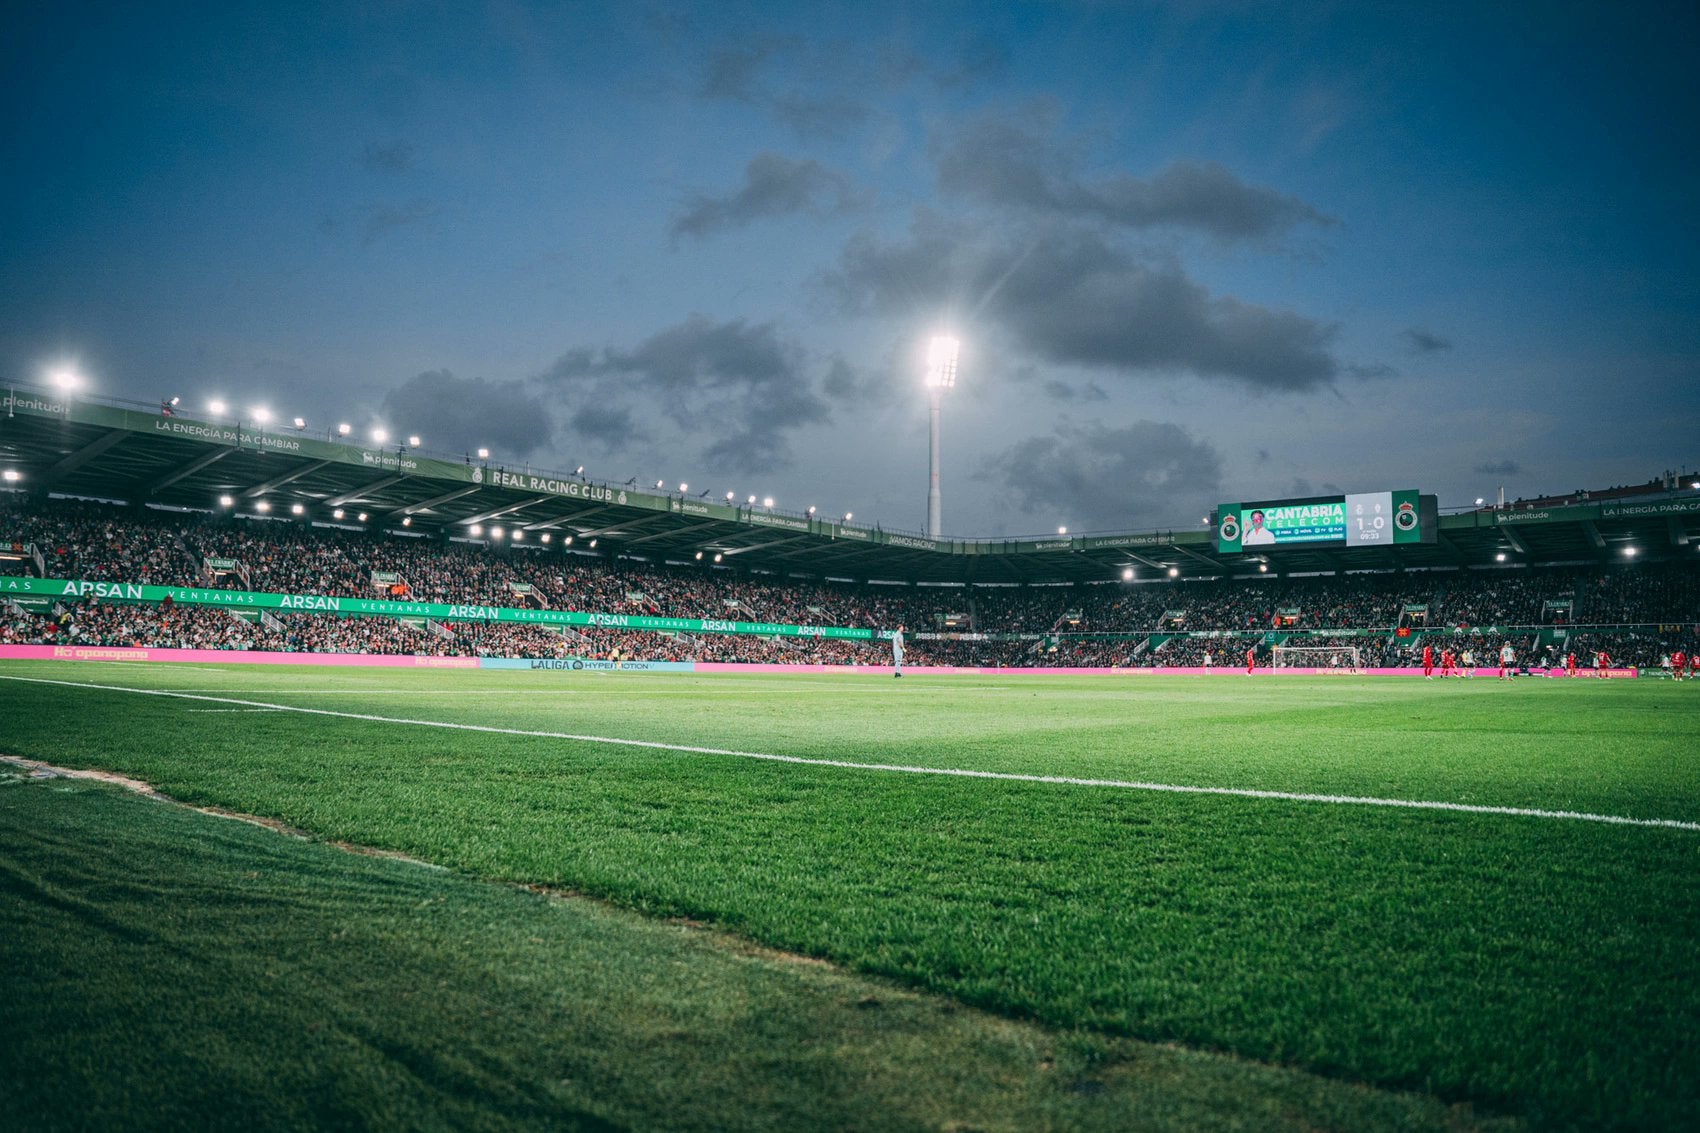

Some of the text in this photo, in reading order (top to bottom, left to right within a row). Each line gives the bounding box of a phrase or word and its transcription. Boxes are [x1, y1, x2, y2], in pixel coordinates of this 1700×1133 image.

[156, 421, 299, 450] LA ENERGÍA PARA CAMBIAR
[375, 456, 417, 469] plenitude
[493, 471, 613, 500] REAL RACING CLUB
[1265, 504, 1343, 520] CANTABRIA
[1660, 504, 1687, 512] PARA
[1266, 517, 1344, 529] TELECOM
[1508, 512, 1549, 522] plenitude
[0, 581, 31, 590] AS
[62, 581, 142, 599] ARSAN
[168, 591, 340, 611] VENTANAS ARSAN
[361, 603, 499, 619] VENTANAS ARSAN
[515, 612, 628, 626] VENTANAS ARSAN
[642, 620, 736, 631] VENTANAS ARSAN
[746, 625, 826, 636] VENTANAS ARSAN
[531, 660, 570, 670] LALIGA
